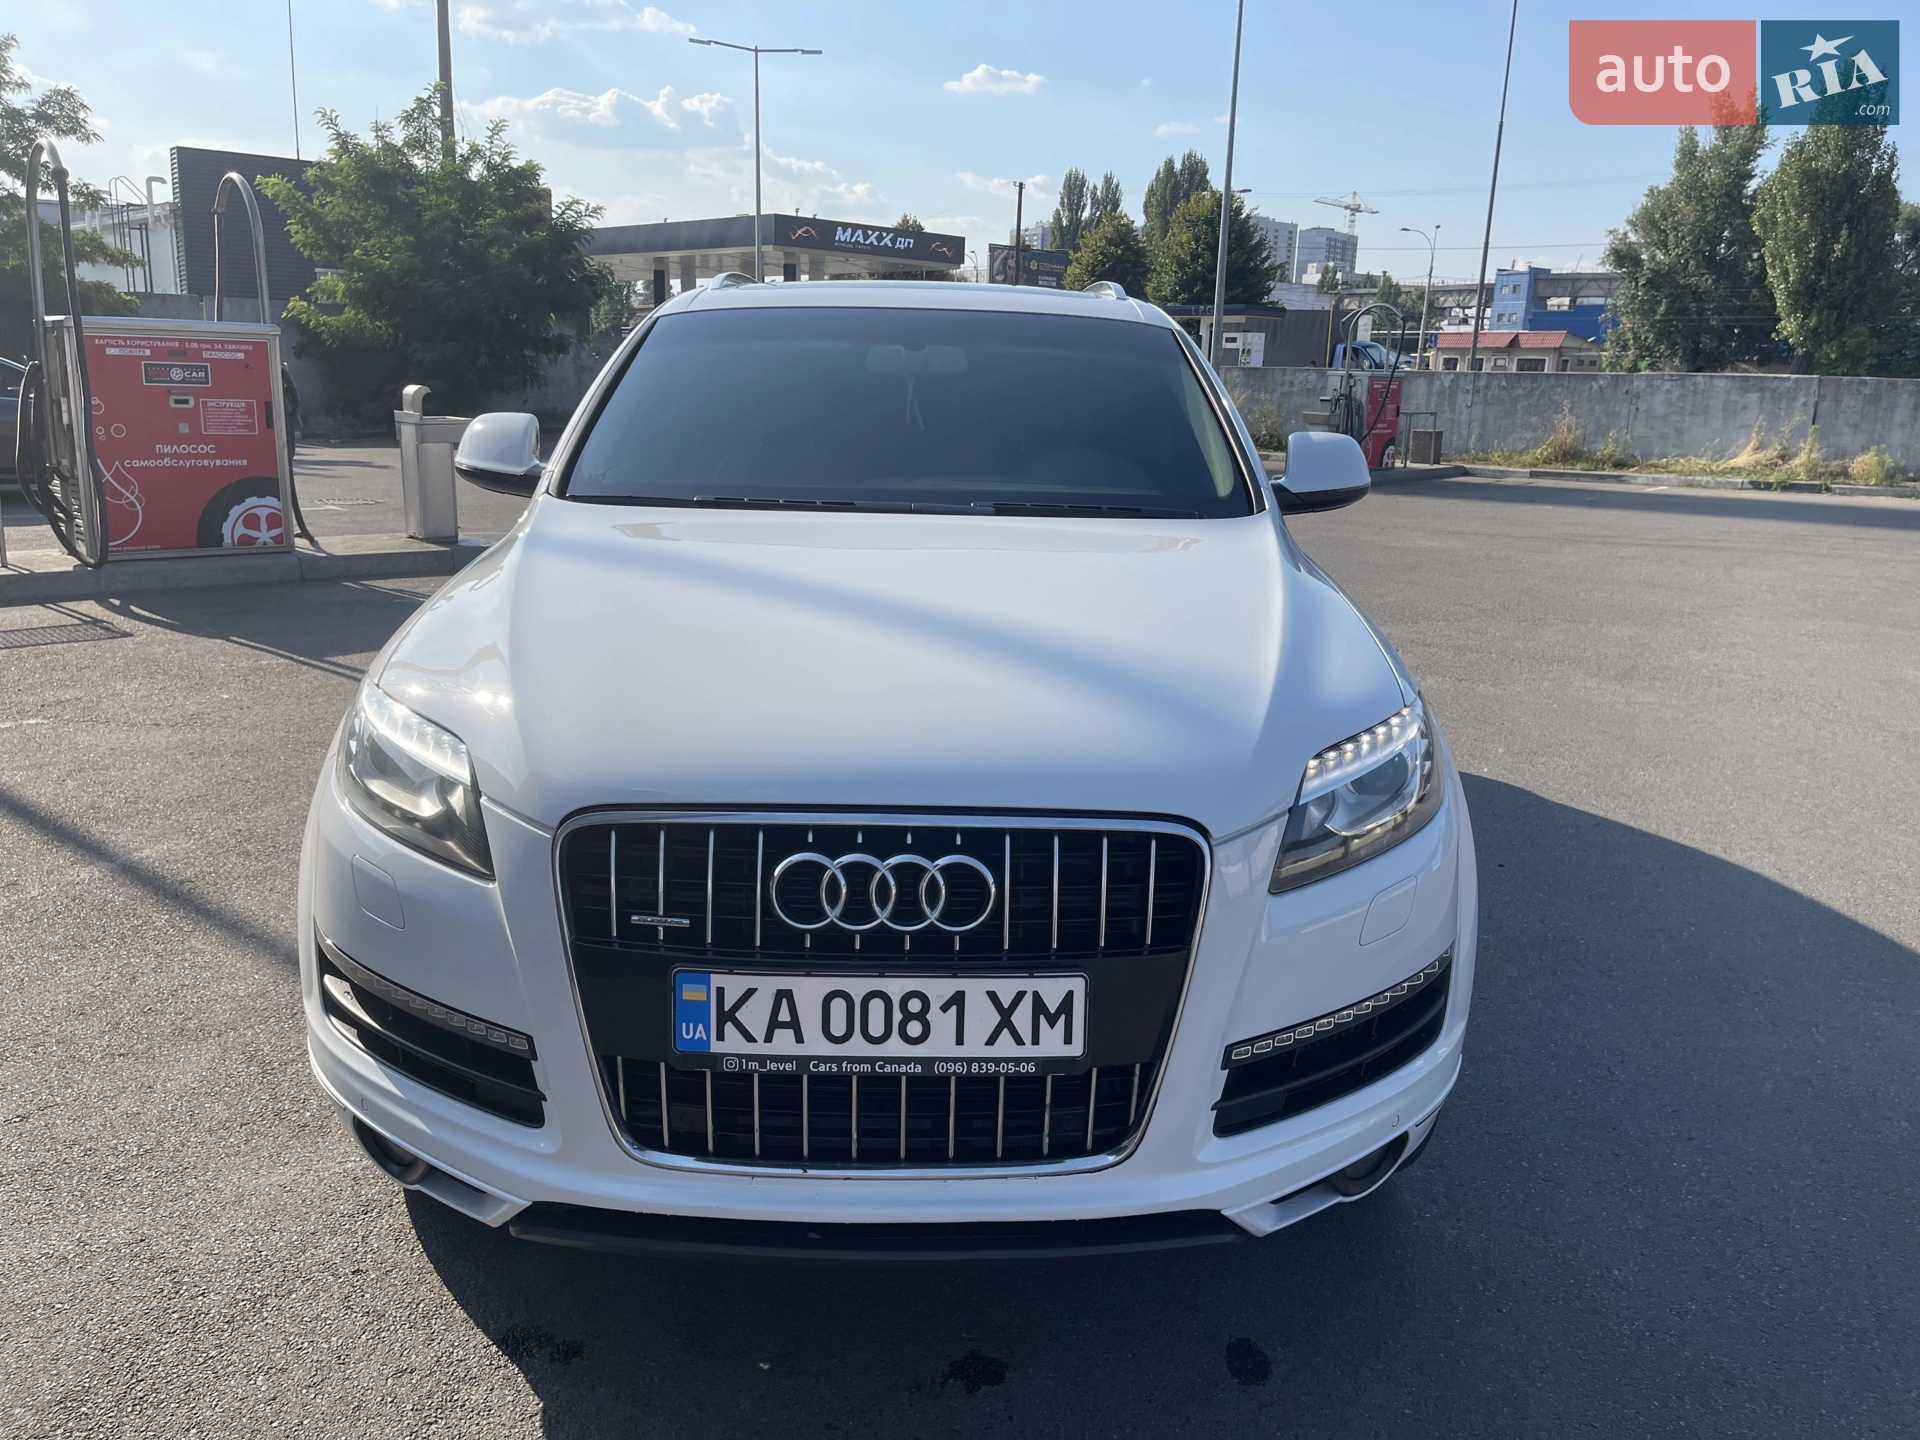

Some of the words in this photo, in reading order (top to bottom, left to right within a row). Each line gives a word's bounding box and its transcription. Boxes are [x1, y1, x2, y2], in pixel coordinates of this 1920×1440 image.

[834, 226, 895, 247] MAXX
[895, 237, 915, 250] ДП
[155, 444, 216, 454] ПИЛОСОС
[124, 457, 248, 468] самообслуговування
[714, 985, 805, 1044] KA
[821, 988, 966, 1046] 0081
[983, 989, 1075, 1046] XM
[682, 1022, 707, 1041] UA
[741, 1058, 797, 1072] 1m_level
[809, 1060, 838, 1072] Cars
[841, 1060, 871, 1072] from
[874, 1060, 922, 1073] Canada
[934, 1061, 968, 1074] (096)
[971, 1062, 1036, 1074] 839-05-06
